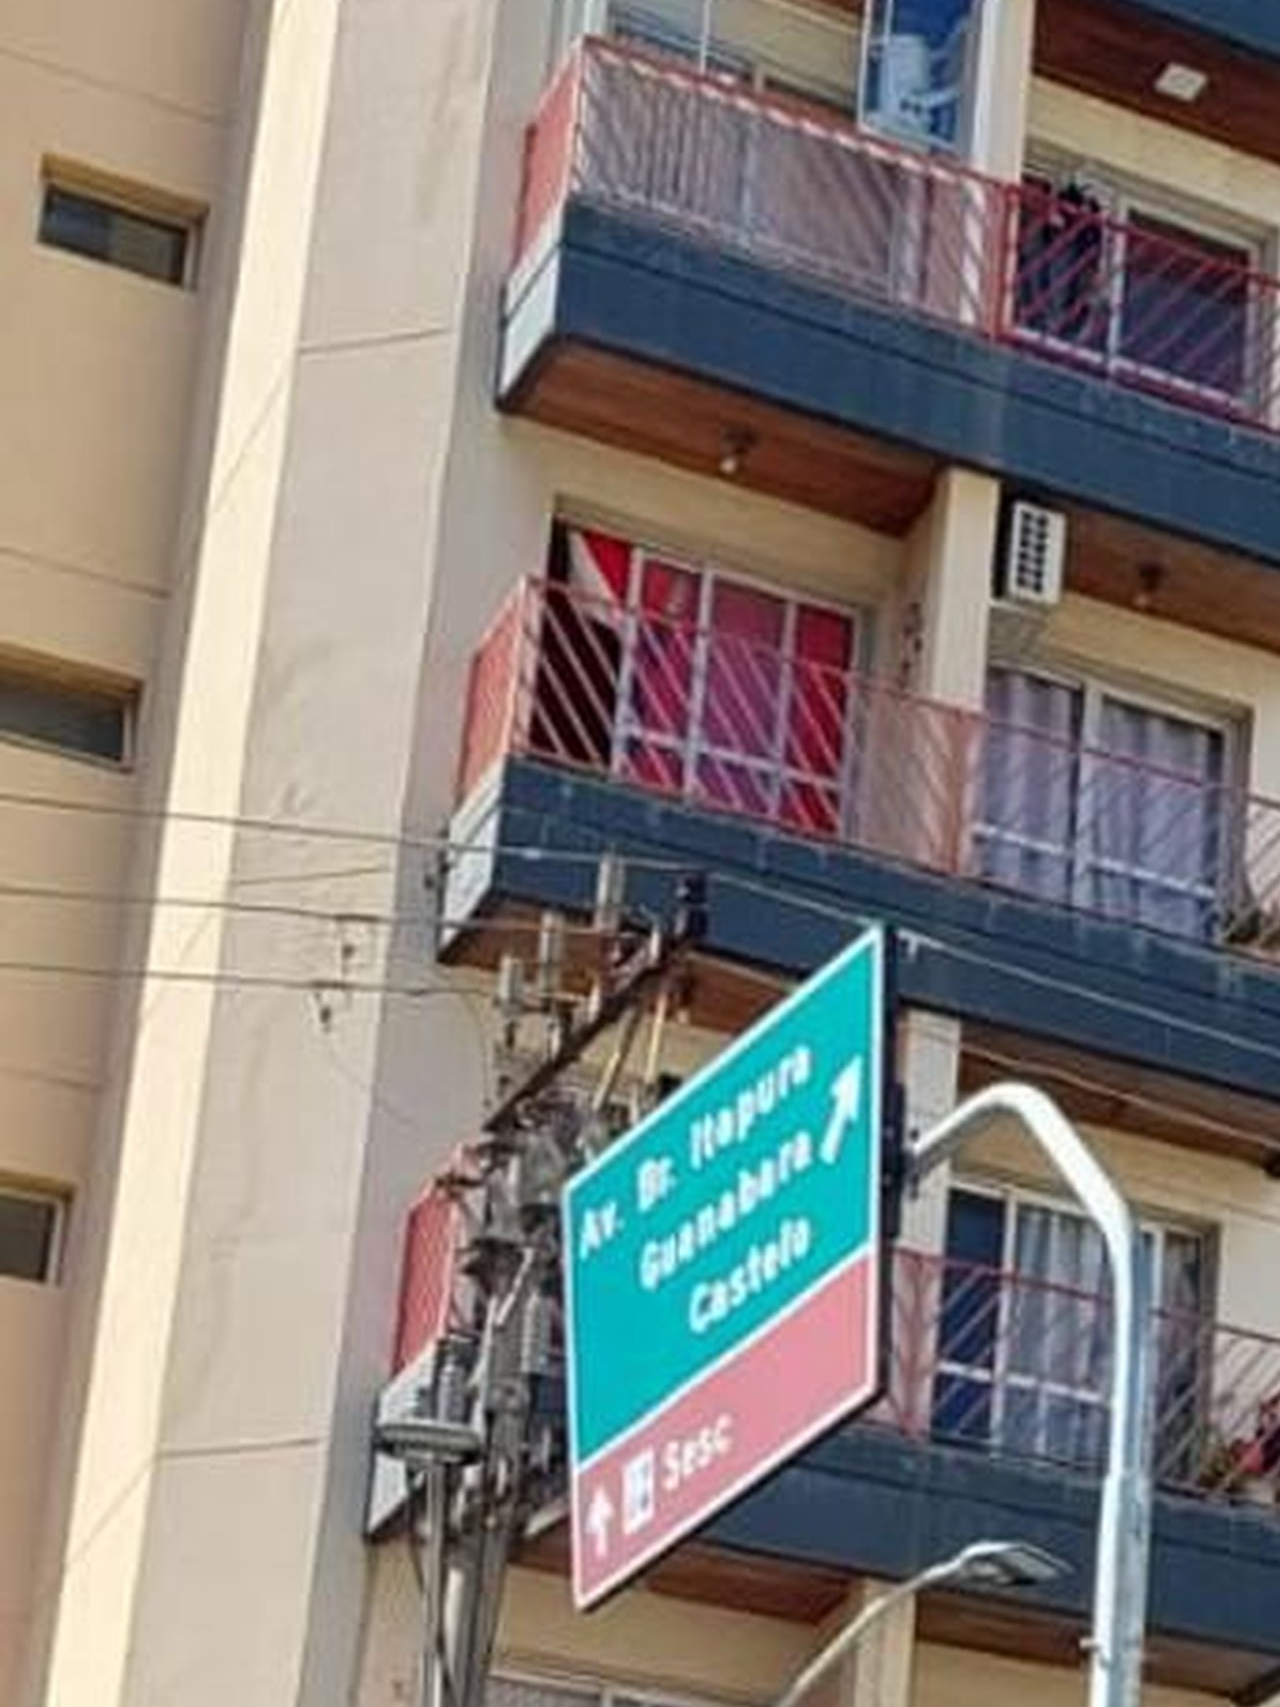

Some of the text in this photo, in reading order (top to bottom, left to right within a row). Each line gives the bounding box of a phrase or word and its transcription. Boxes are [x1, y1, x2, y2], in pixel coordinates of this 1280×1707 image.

[579, 1200, 625, 1262] Av.
[689, 1044, 812, 1169] Itapura
[640, 1130, 813, 1291] Guanabara
[688, 1217, 811, 1334] Castelo
[661, 1413, 733, 1491] Sesc
